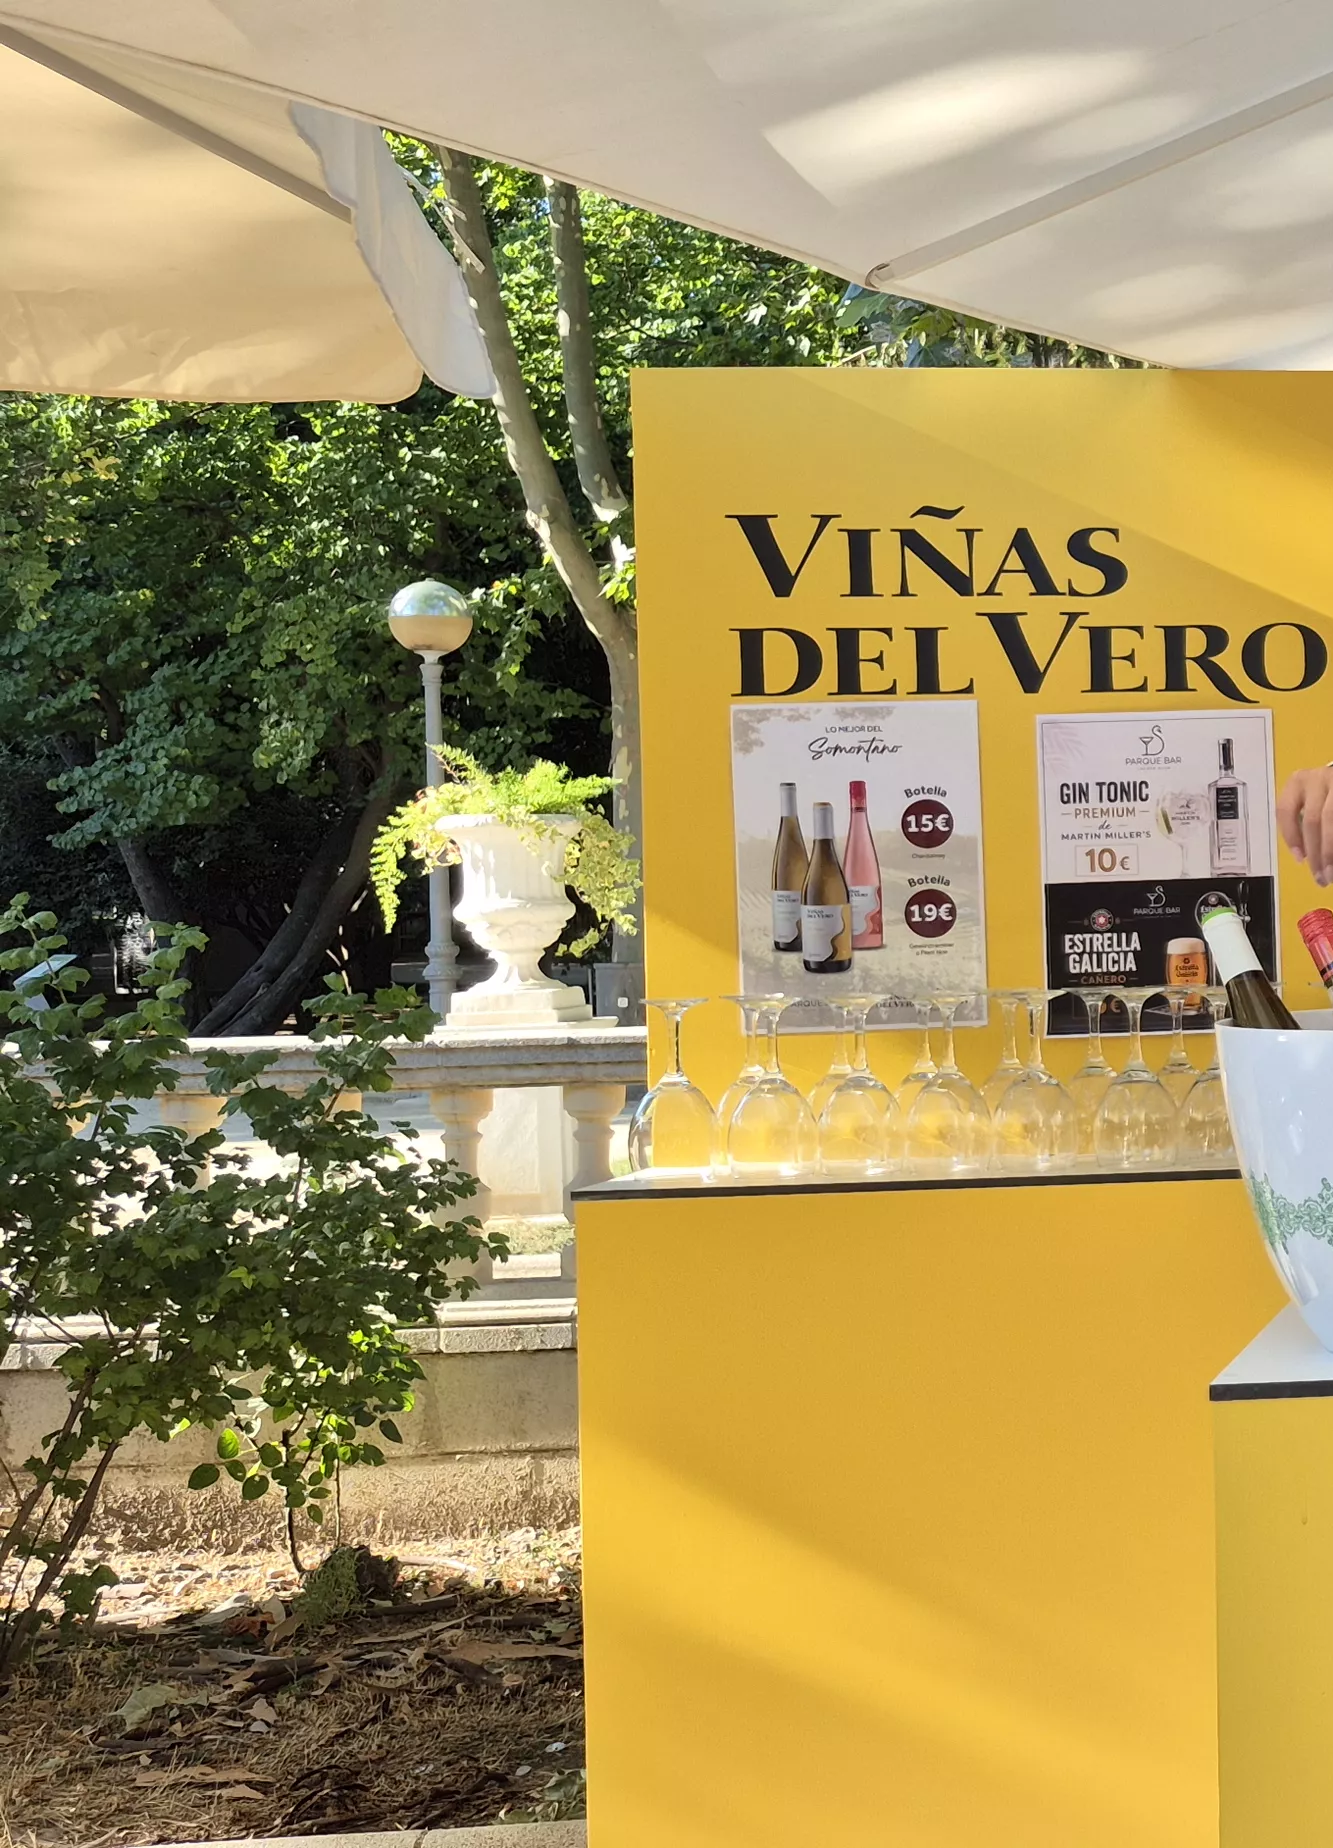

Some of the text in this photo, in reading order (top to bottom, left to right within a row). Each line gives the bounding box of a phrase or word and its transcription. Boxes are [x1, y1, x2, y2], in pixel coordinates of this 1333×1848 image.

[724, 505, 1128, 598] VIÑAS
[729, 611, 1328, 704] DEL VERO
[808, 736, 903, 763] Somontano
[1125, 756, 1182, 765] PARQUE BAR
[903, 785, 947, 798] Botella
[1060, 780, 1150, 805] GIN TONIC
[906, 813, 950, 833] 15€
[1074, 807, 1136, 819] PREMIUM
[1098, 820, 1112, 831] de
[1061, 831, 1152, 841] MARTIN MILLER'S
[907, 875, 951, 888] Botella
[909, 903, 953, 923] 19€
[1165, 906, 1181, 914] BAR
[1064, 931, 1141, 954] ESTRELLA
[1068, 951, 1137, 974] GALICIA
